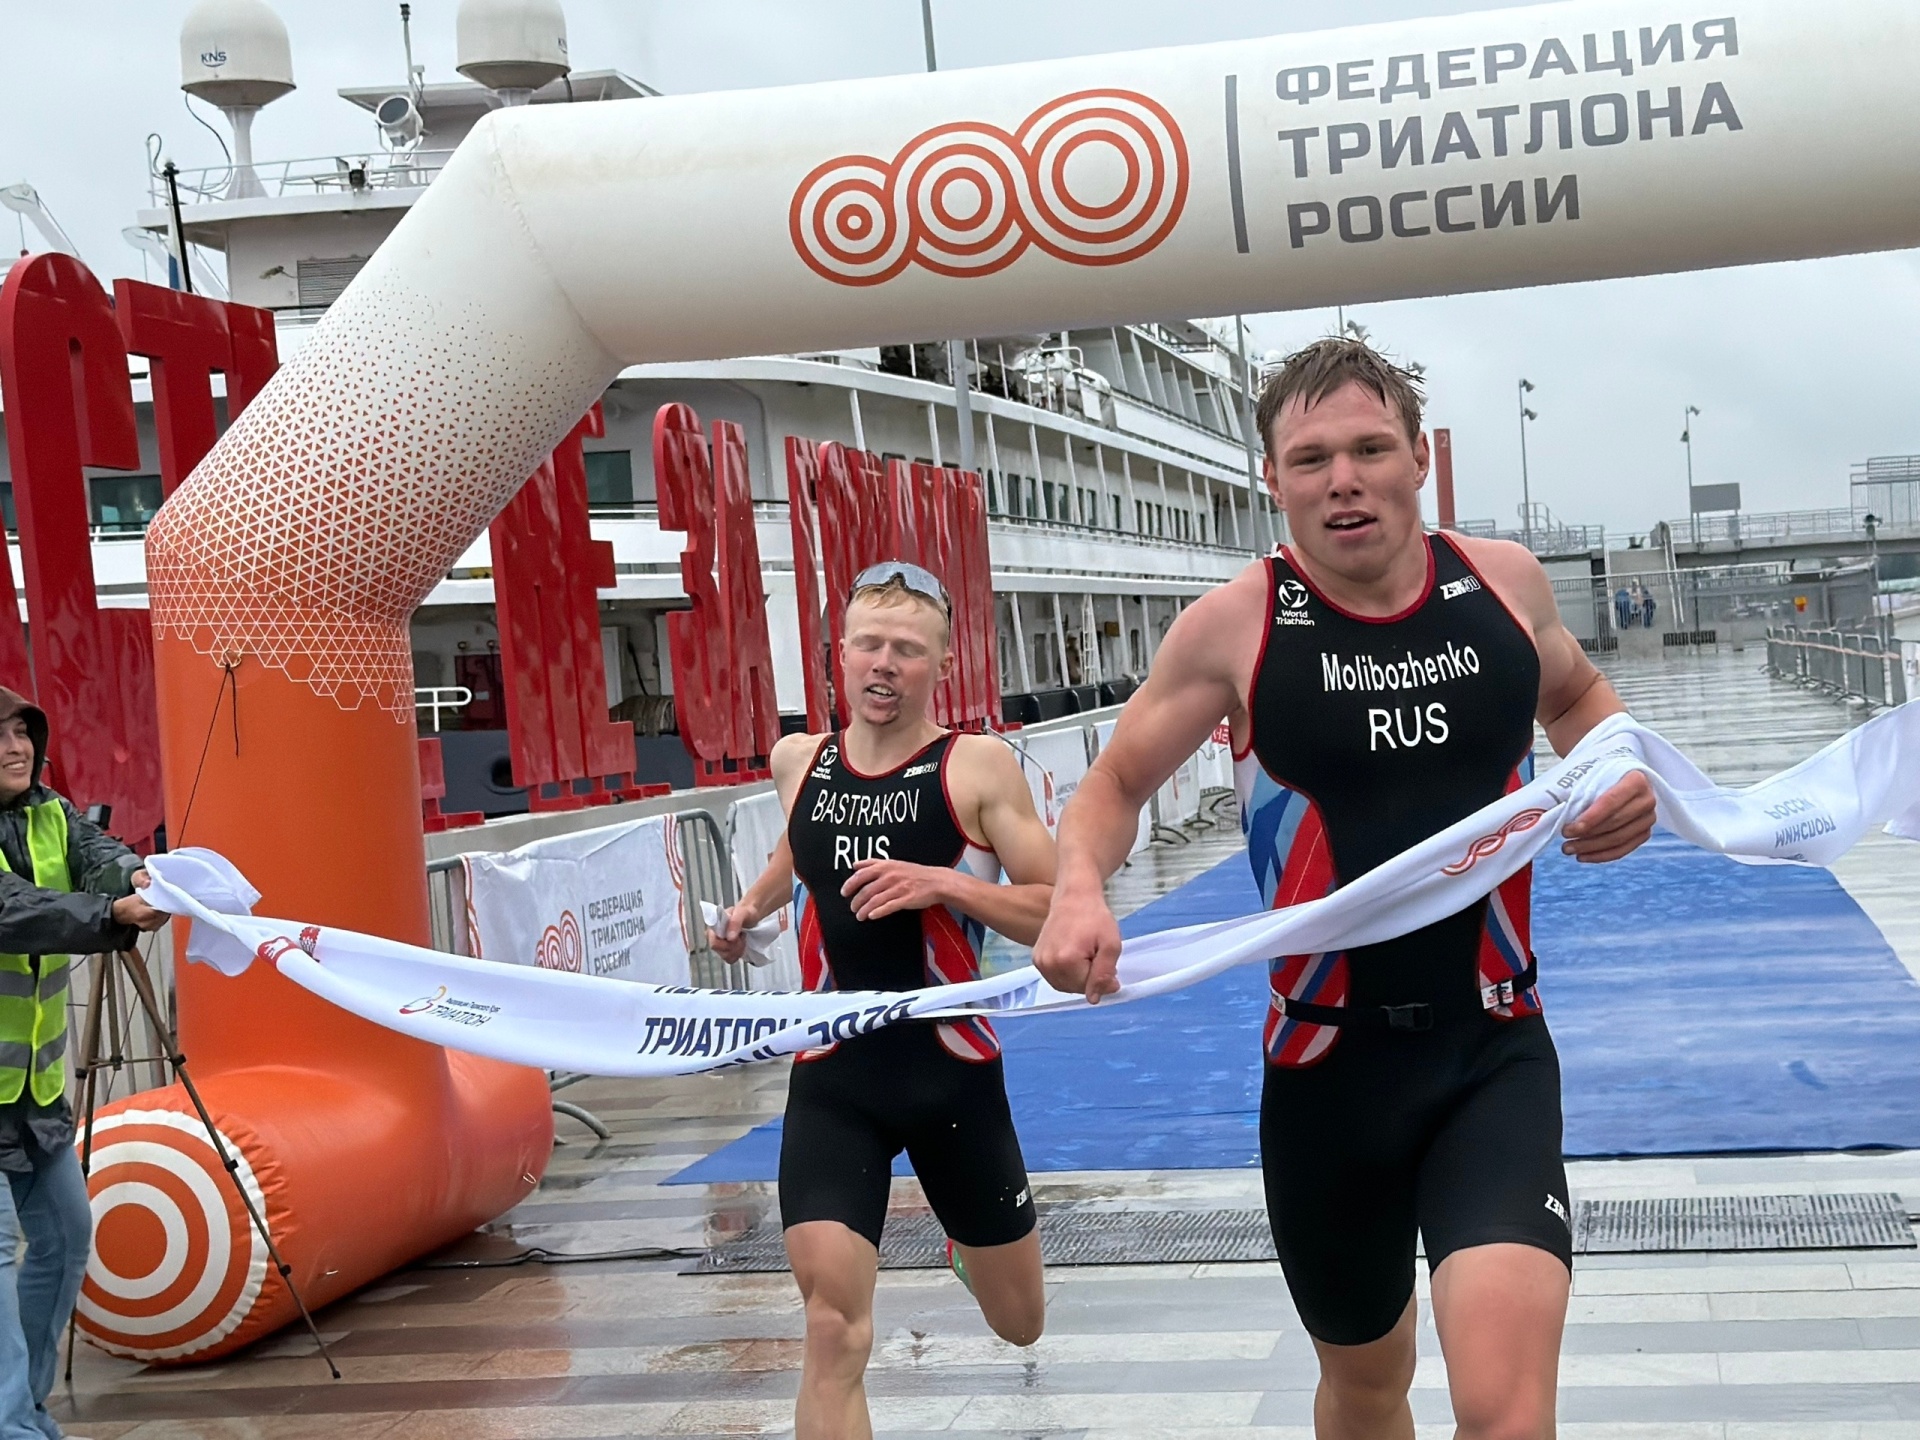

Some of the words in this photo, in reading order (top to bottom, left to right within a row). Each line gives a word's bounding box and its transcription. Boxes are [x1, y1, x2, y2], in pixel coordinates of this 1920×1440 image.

[201, 51, 227, 62] KNS
[1276, 17, 1739, 105] ФЕДЕРАЦИЯ
[1278, 81, 1744, 178] ТРИАТЛОНА
[1287, 174, 1580, 249] РОССИИ
[653, 403, 781, 762] ЗА
[1276, 617, 1315, 626] Triathlon
[1281, 610, 1308, 618] World
[1321, 641, 1480, 692] Molibozhenko
[1368, 702, 1449, 751] RUS
[811, 789, 920, 826] BASTRAKOV
[834, 835, 890, 870] RUS
[589, 889, 644, 920] ФЕДЕРАЦИЯ
[591, 916, 646, 949] ТРИАТЛОНА
